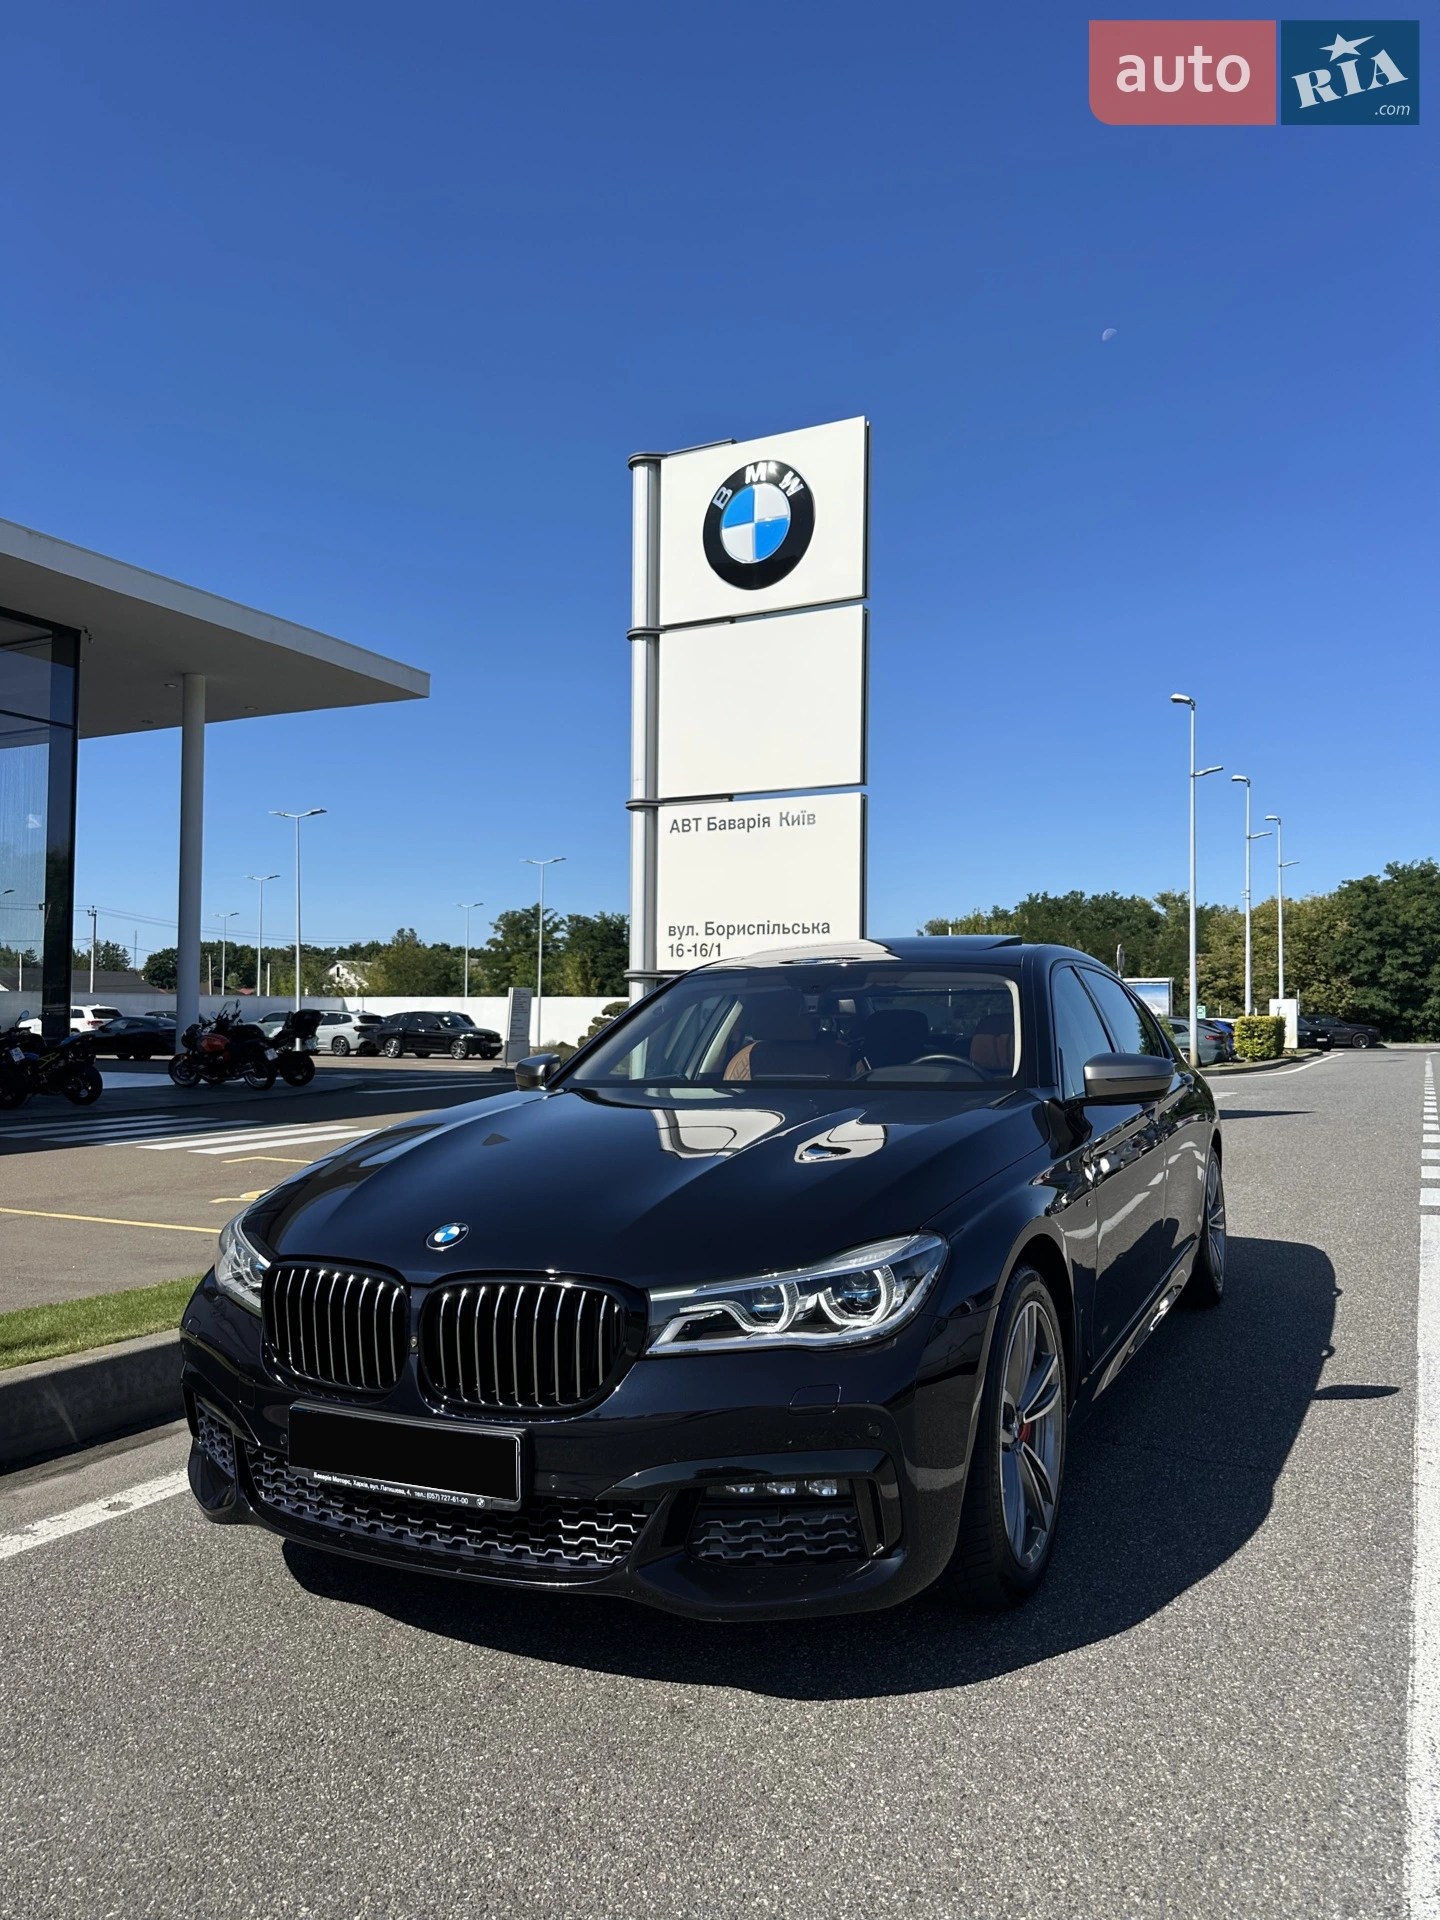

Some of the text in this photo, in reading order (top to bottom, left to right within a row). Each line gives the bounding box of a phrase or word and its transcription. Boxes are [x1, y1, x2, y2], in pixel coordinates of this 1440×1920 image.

[712, 461, 805, 510] BMW
[669, 810, 817, 833] АВТ Баварія Київ
[668, 920, 831, 940] вул. Бориспільська
